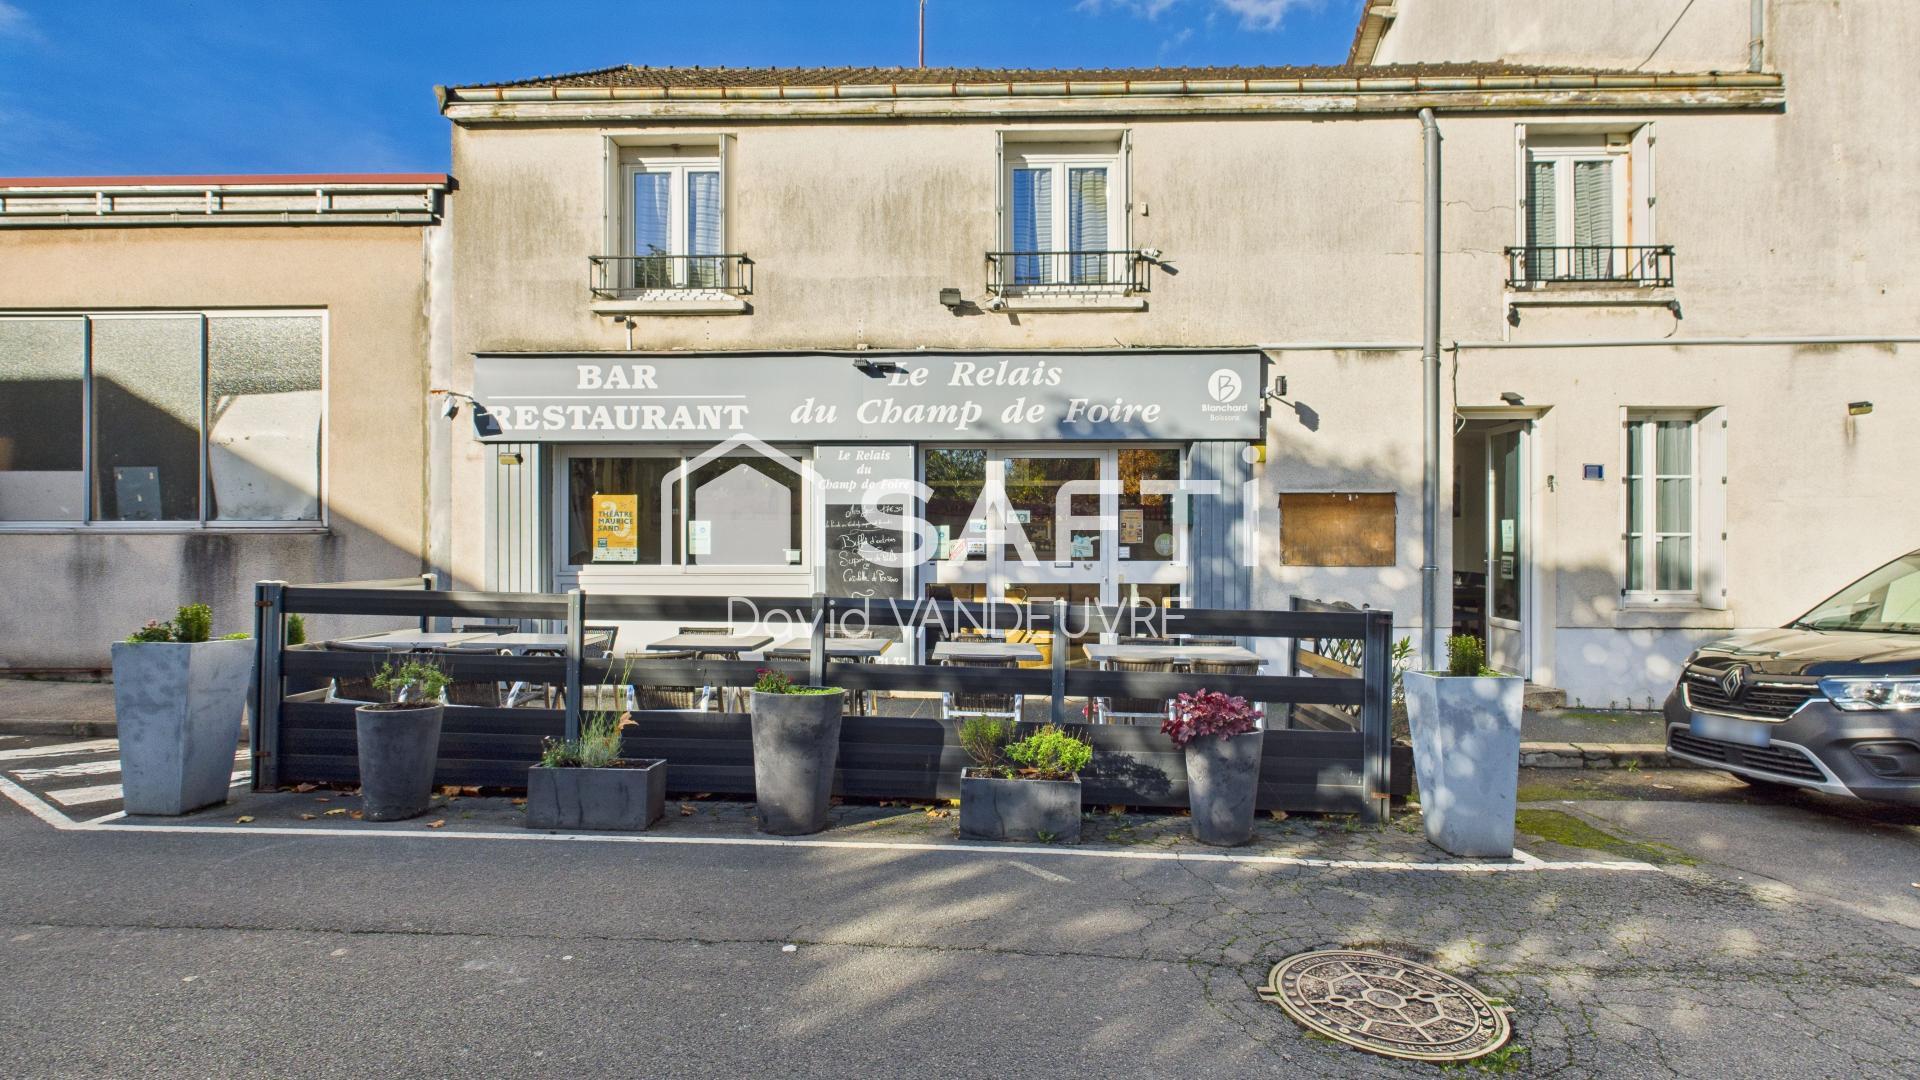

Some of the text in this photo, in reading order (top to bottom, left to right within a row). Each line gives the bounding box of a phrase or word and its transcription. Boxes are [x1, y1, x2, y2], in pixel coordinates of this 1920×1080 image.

[576, 364, 658, 390] BAR
[887, 360, 1063, 387] Le Relais
[486, 404, 749, 430] RESTAURANT
[790, 397, 1161, 431] du Champ de Foire
[1201, 403, 1248, 412] Blanchard
[838, 449, 891, 461] Le Relais
[856, 464, 872, 475] du
[818, 479, 857, 492] Champ
